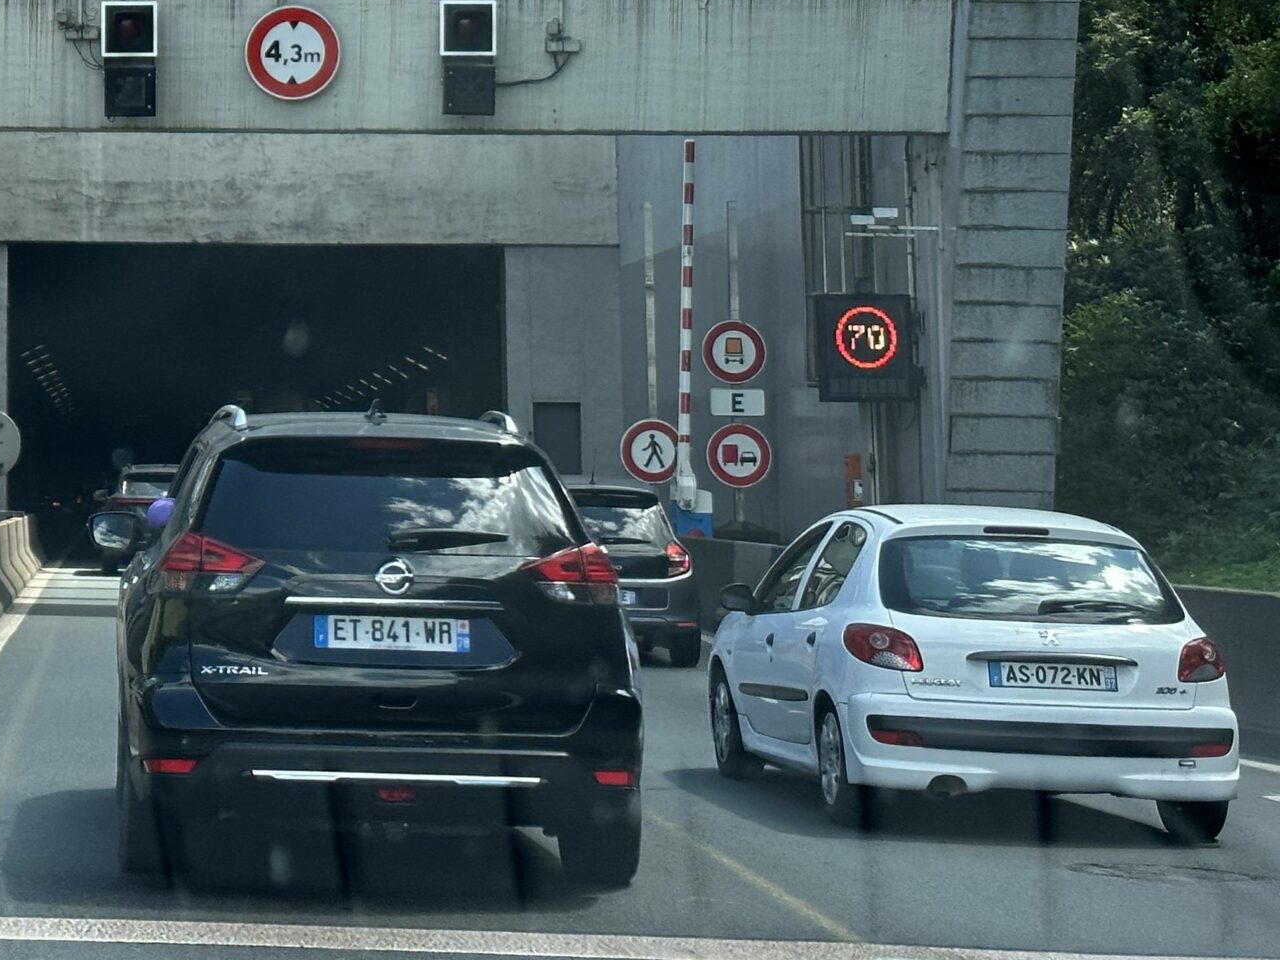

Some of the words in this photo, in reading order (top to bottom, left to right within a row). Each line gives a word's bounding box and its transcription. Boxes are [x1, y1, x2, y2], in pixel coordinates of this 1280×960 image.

[264, 40, 321, 66] 4,3m
[848, 324, 885, 350] 70
[731, 393, 745, 413] E
[200, 665, 270, 676] X-TRAIL
[1005, 664, 1102, 687] AS-072-KN
